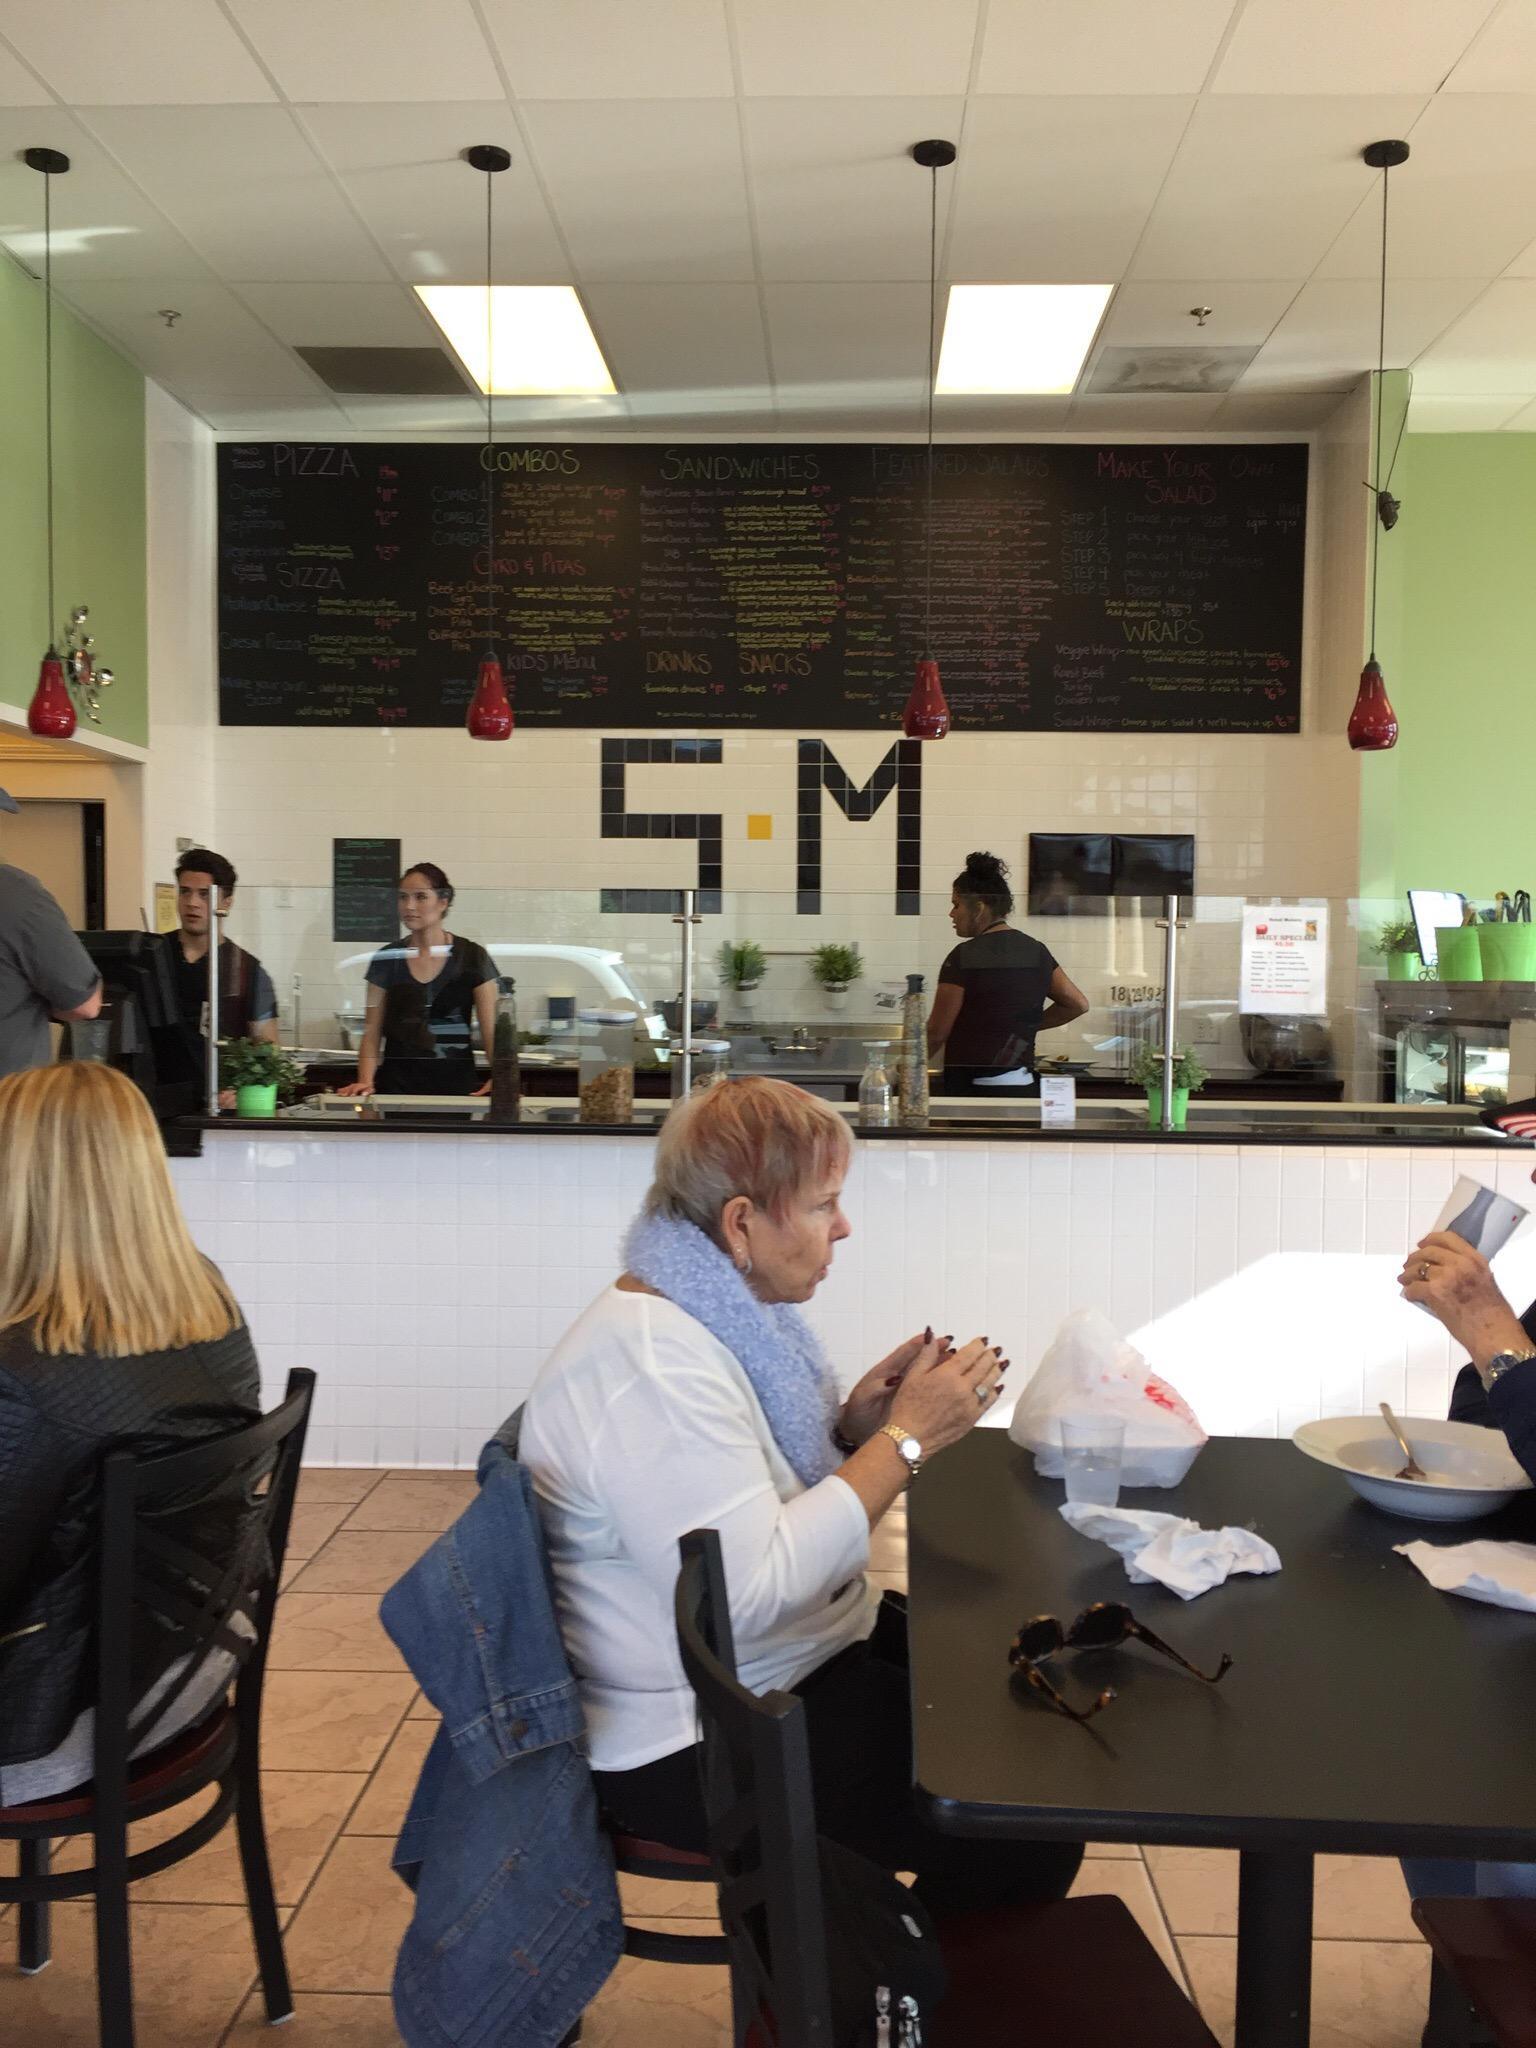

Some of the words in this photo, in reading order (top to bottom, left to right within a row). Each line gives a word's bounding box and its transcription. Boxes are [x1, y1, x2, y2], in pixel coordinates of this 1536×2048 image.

[272, 443, 359, 478] PIZZA
[480, 446, 581, 475] COMBOS
[660, 449, 820, 481] SANDWICHES
[1097, 451, 1155, 480] MAKE
[1164, 449, 1214, 480] YOUR
[1145, 480, 1217, 505] SALAD
[275, 562, 346, 591] SIZZA
[1122, 619, 1206, 645] WRAPS
[646, 650, 714, 676] DRINKS
[739, 652, 813, 677] SNACKS
